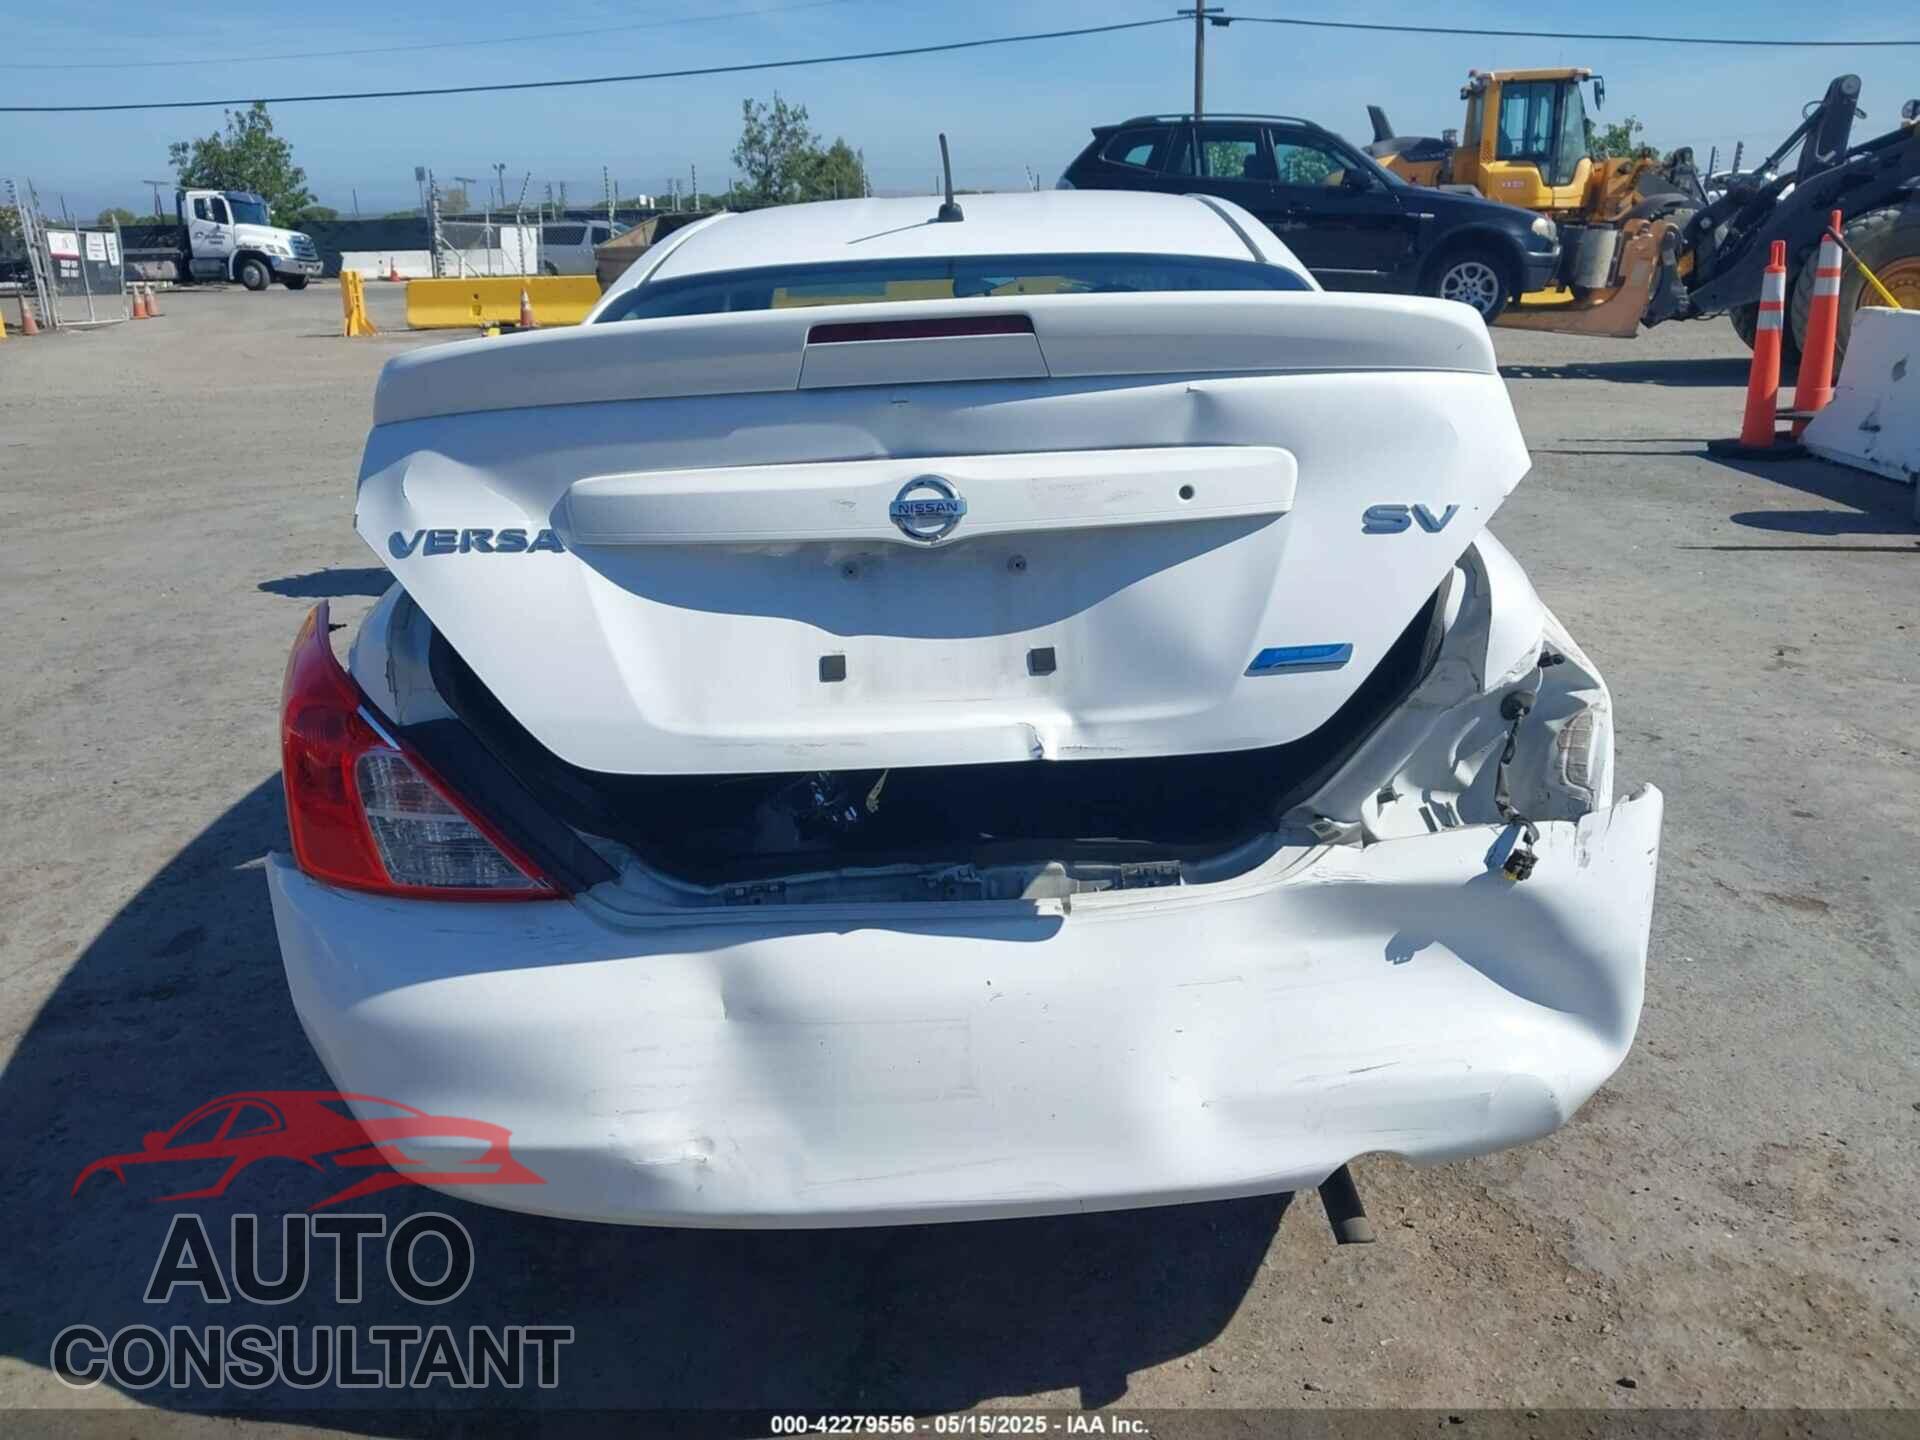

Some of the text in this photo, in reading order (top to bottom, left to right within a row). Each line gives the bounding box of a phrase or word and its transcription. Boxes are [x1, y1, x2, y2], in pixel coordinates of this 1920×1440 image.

[897, 502, 958, 514] NISSAN
[1361, 503, 1460, 534] SV
[388, 528, 566, 560] VERSA
